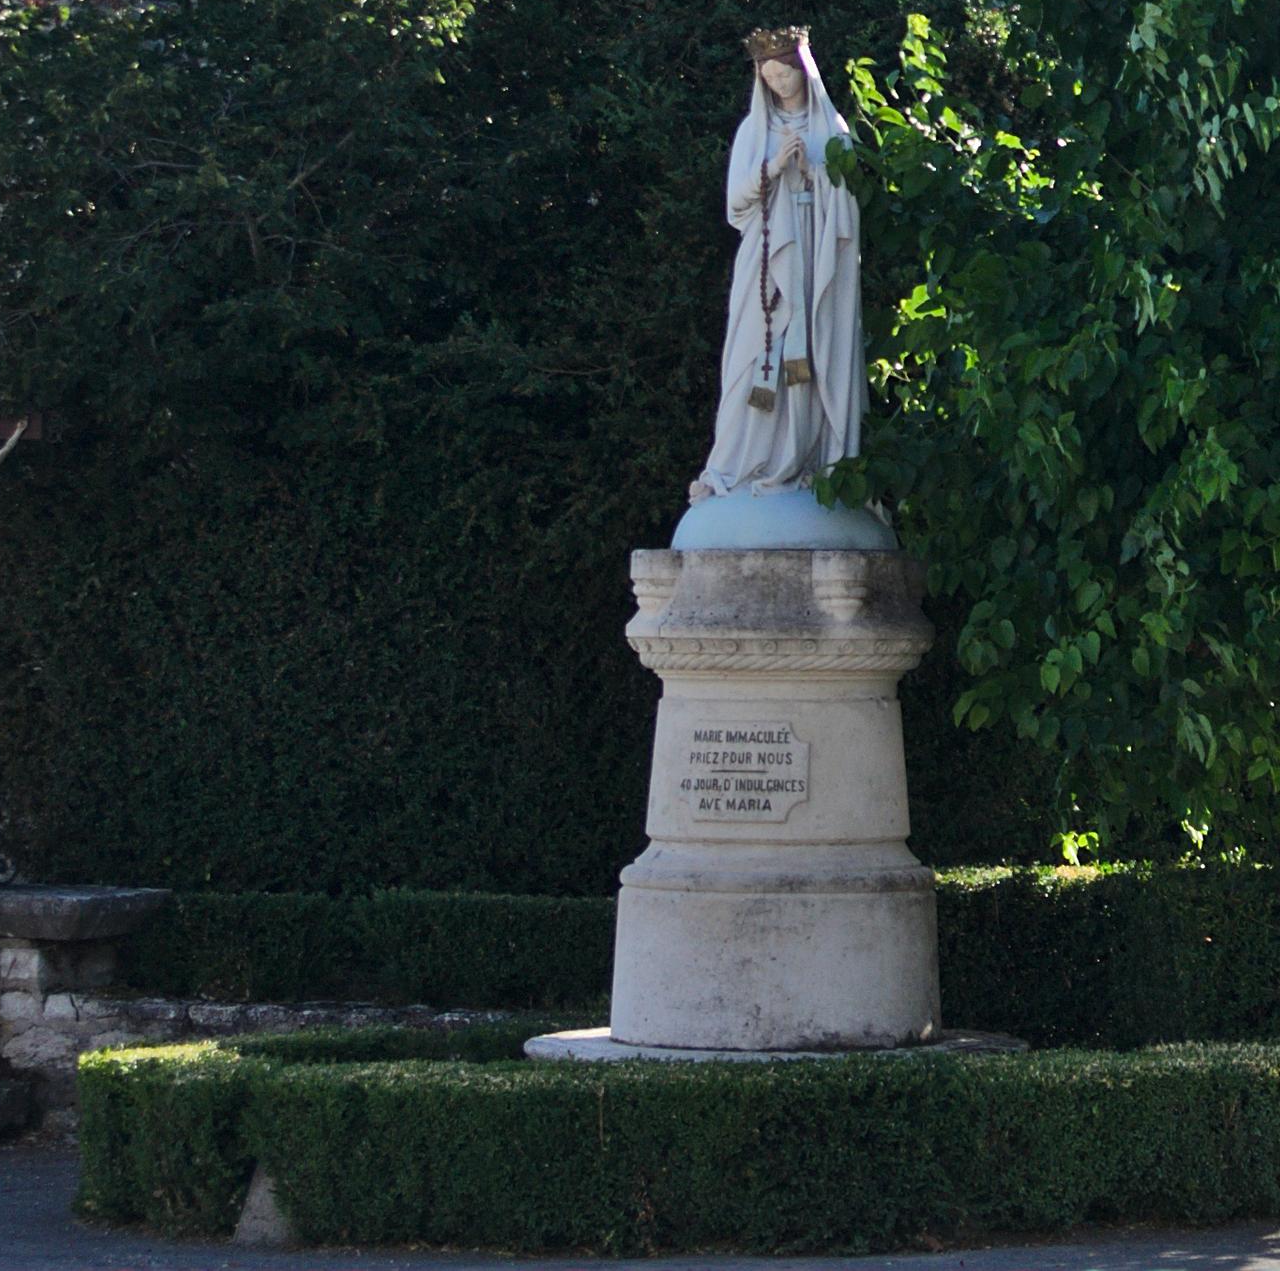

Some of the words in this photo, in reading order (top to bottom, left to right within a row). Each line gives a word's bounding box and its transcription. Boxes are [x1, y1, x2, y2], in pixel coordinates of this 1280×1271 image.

[694, 730, 723, 744] MARIE
[725, 727, 791, 744] IMMACULÉE
[689, 751, 719, 765] PRIEZ
[722, 752, 752, 765] POUR
[758, 752, 793, 765] NOUS
[680, 778, 692, 791] 40
[699, 798, 721, 811] AVE
[726, 798, 772, 812] MARIA
